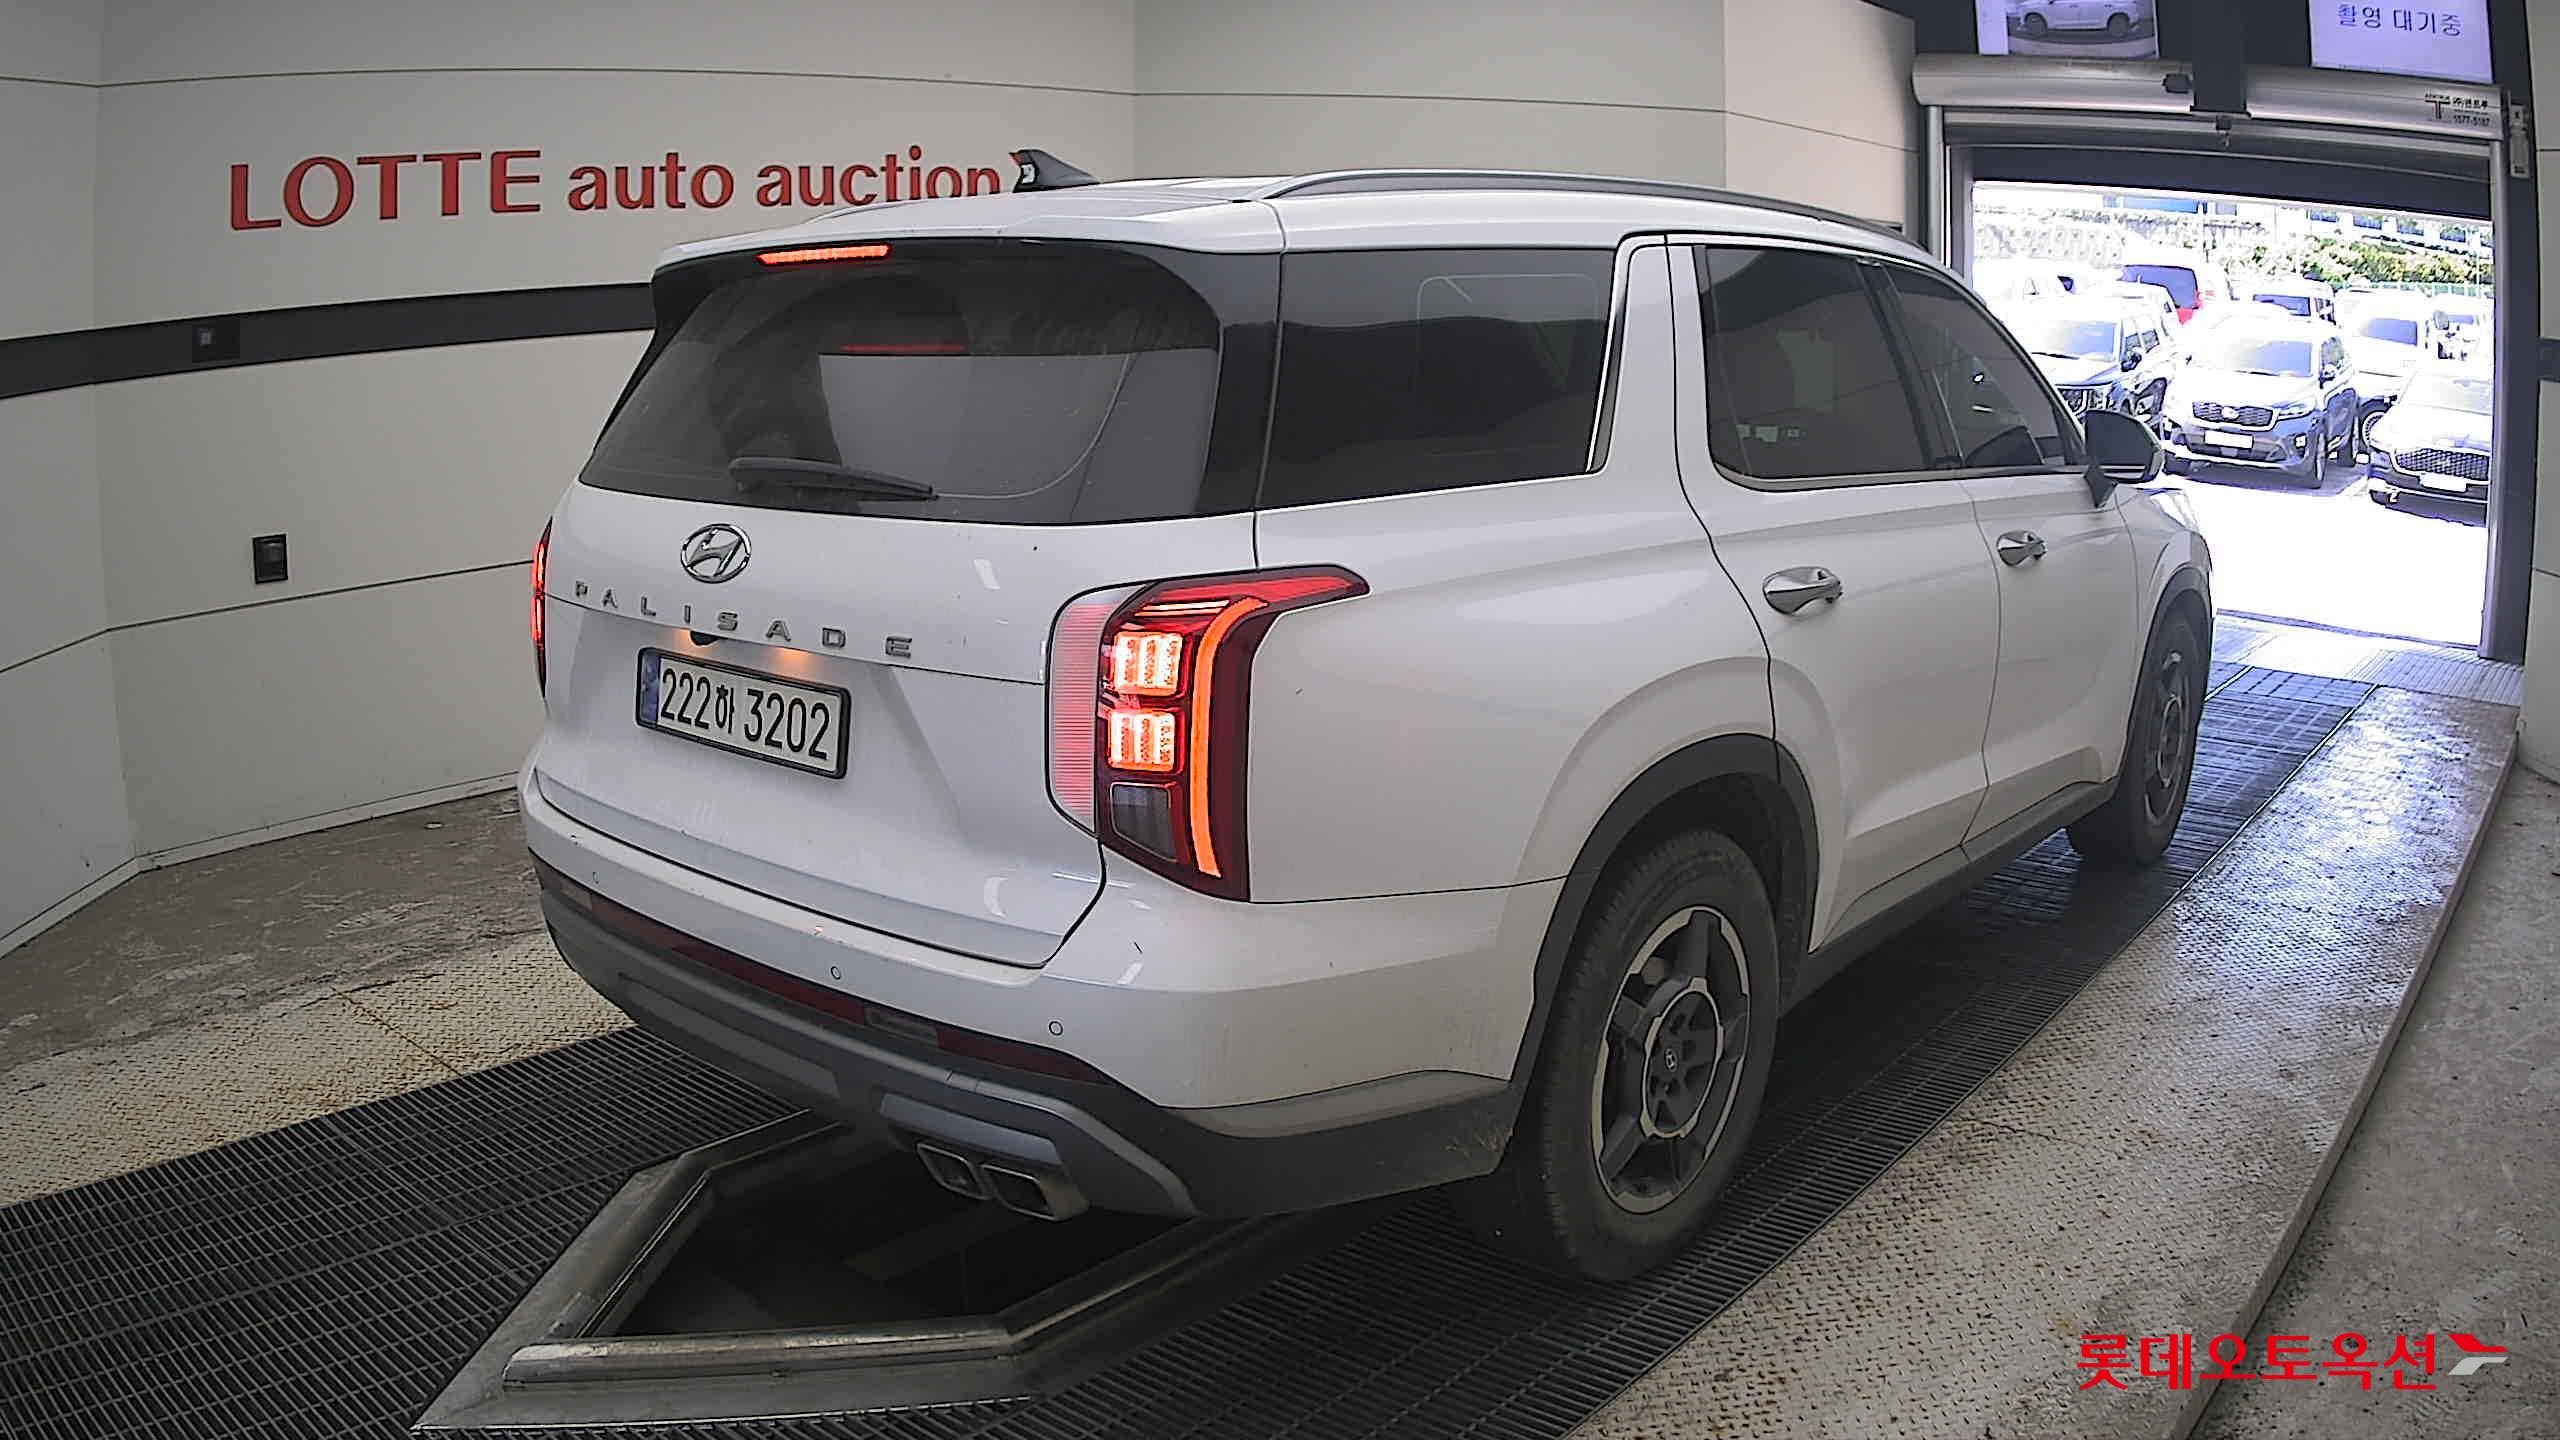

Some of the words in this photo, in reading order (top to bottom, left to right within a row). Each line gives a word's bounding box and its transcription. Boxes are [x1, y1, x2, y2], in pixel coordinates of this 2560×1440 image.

[2338, 4, 2382, 29] 촬영
[2393, 8, 2461, 37] 대기중
[230, 150, 541, 231] LOTTE
[567, 151, 735, 211] auto
[755, 144, 1002, 208] auction
[574, 580, 914, 659] PALISADE
[660, 667, 736, 735] 222하
[743, 687, 831, 761] 3202
